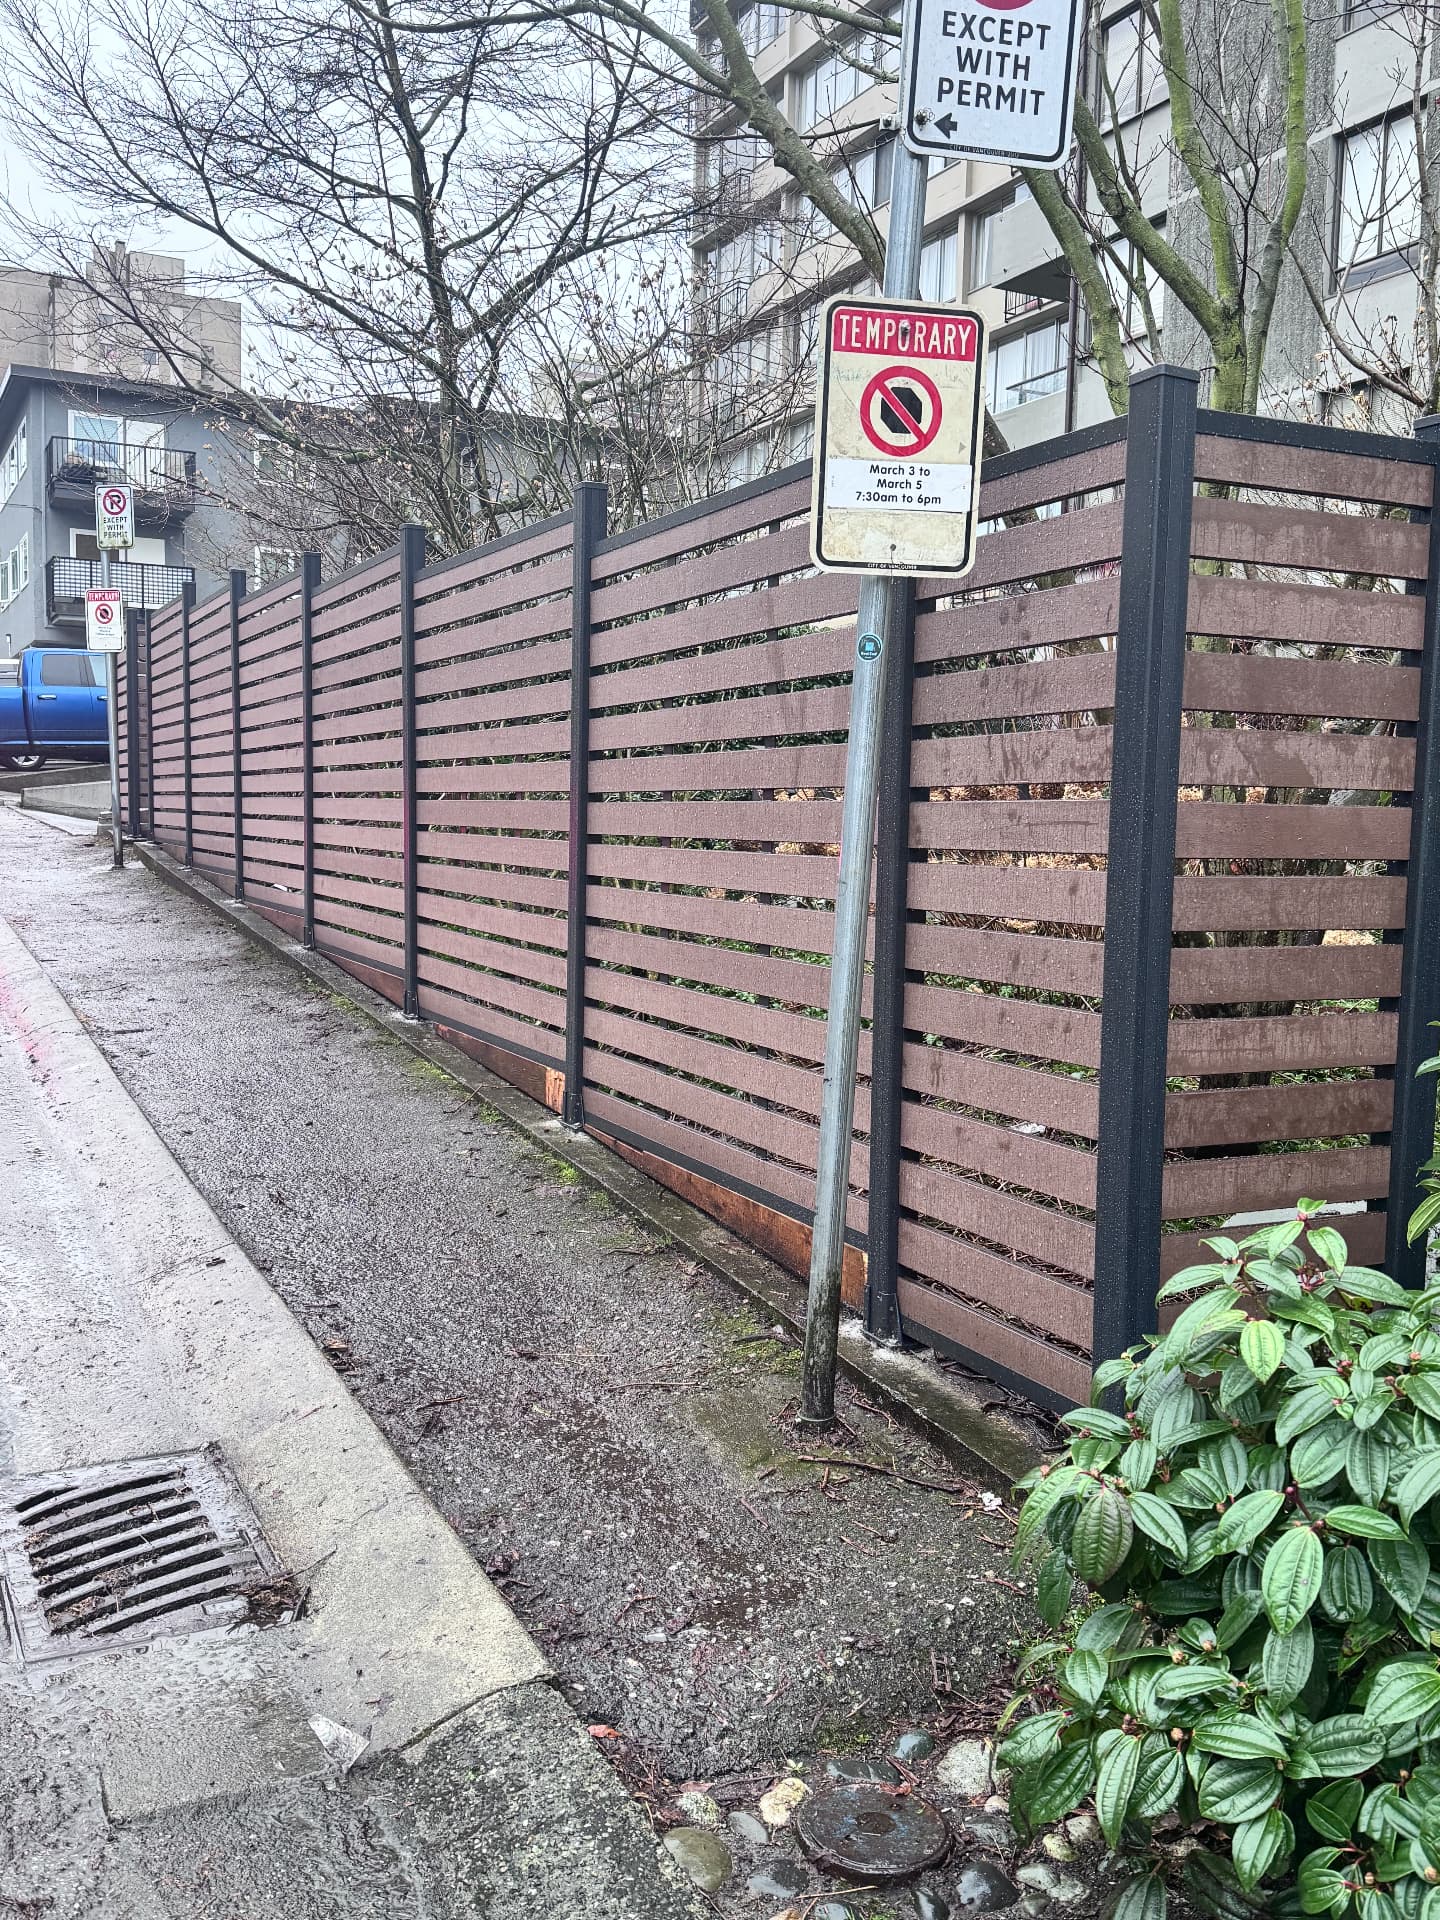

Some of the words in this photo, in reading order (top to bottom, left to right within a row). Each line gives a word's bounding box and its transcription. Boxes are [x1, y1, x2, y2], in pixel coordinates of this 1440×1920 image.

[942, 10, 1051, 50] EXCEPT
[956, 46, 1031, 81] WITH
[937, 77, 1046, 115] PERMIT
[839, 314, 972, 356] TEMPORARY
[869, 463, 905, 475] March
[908, 466, 915, 476] 3
[919, 466, 931, 477] to
[876, 478, 912, 489] March
[915, 480, 923, 490] 5
[856, 491, 898, 503] 7:30am
[902, 493, 913, 503] to
[917, 494, 941, 506] 6pm
[103, 516, 128, 524] EXCEPT
